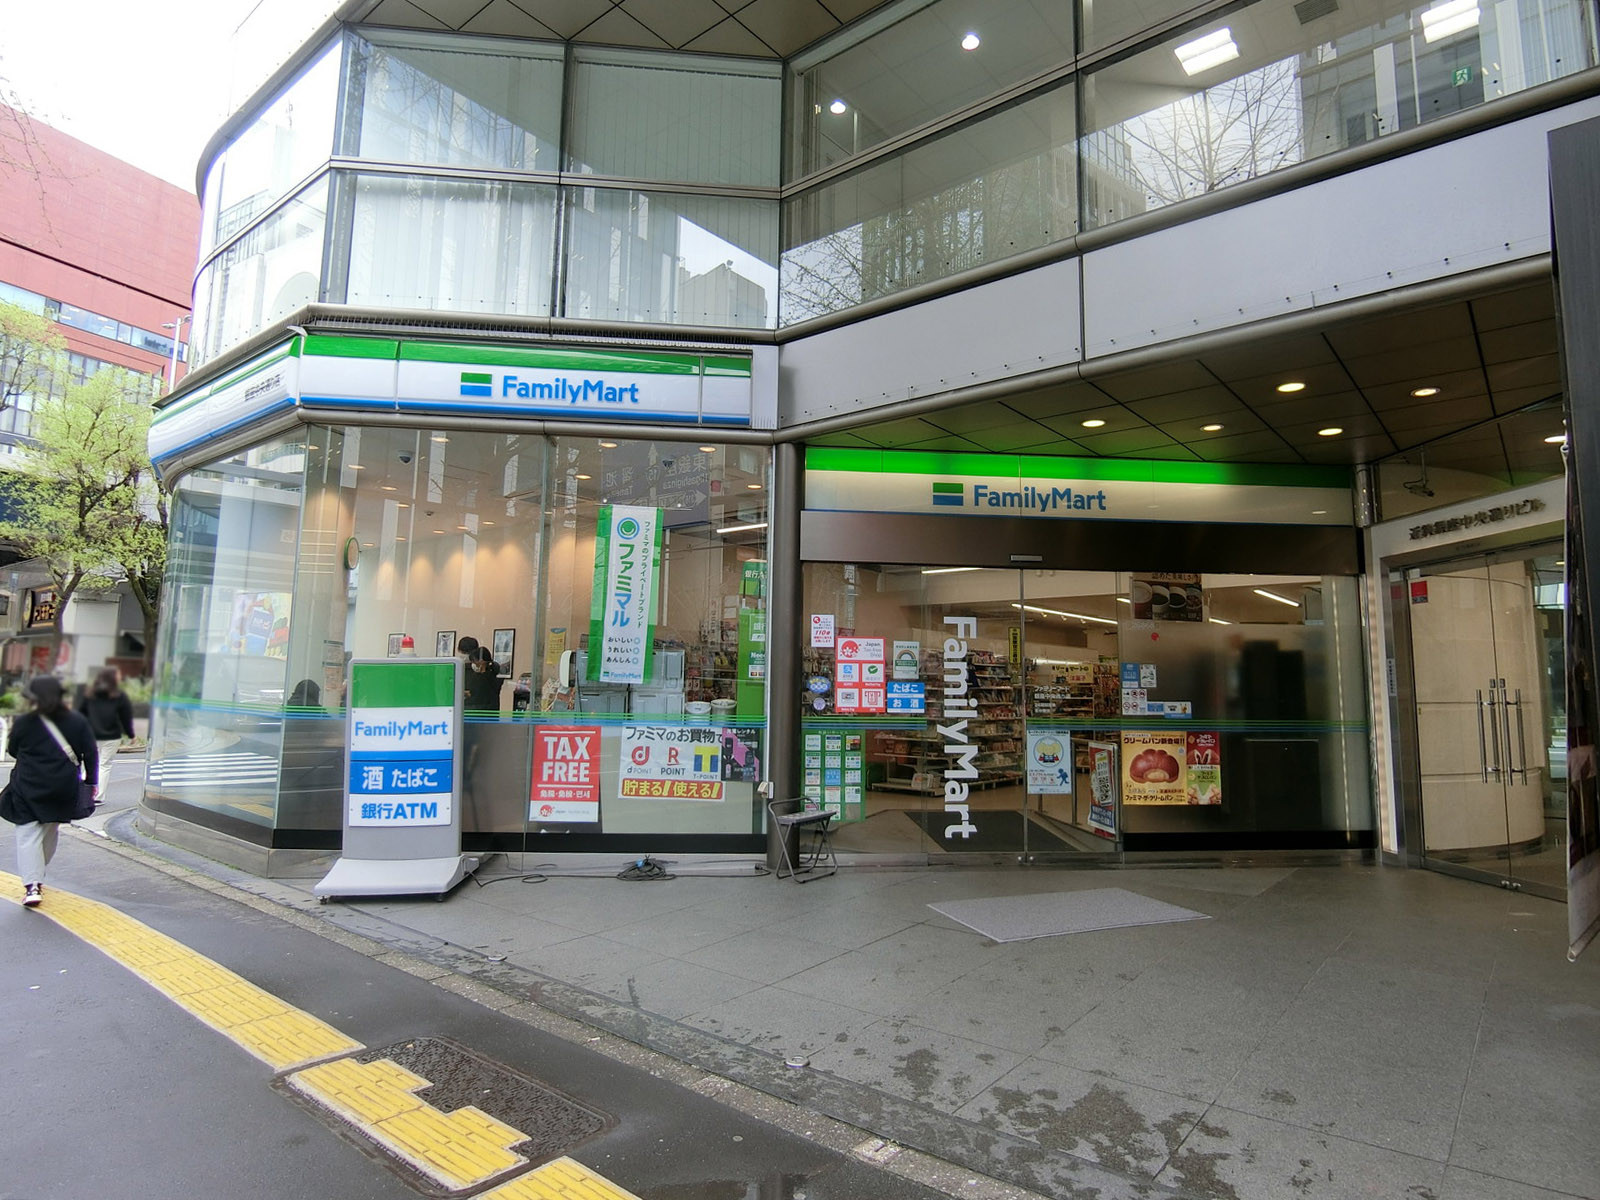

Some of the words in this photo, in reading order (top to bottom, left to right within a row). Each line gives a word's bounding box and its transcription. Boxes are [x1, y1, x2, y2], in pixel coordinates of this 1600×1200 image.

[502, 375, 639, 403] FamilyMart
[974, 484, 1107, 512] FamilyMart
[611, 543, 635, 628] ファミマル
[608, 636, 633, 644] おいしい
[606, 656, 632, 664] あんしん
[610, 671, 641, 680] FamilyMart
[893, 684, 918, 693] たばこ
[355, 721, 448, 740] FamilyMart
[937, 616, 979, 840] FamilyMart
[543, 736, 591, 760] TAX
[667, 747, 680, 766] R
[362, 766, 384, 790] 酒
[391, 768, 438, 788] たばこ
[542, 761, 590, 782] FREE
[660, 767, 686, 775] POINT
[361, 802, 438, 819] 銀行ATM
